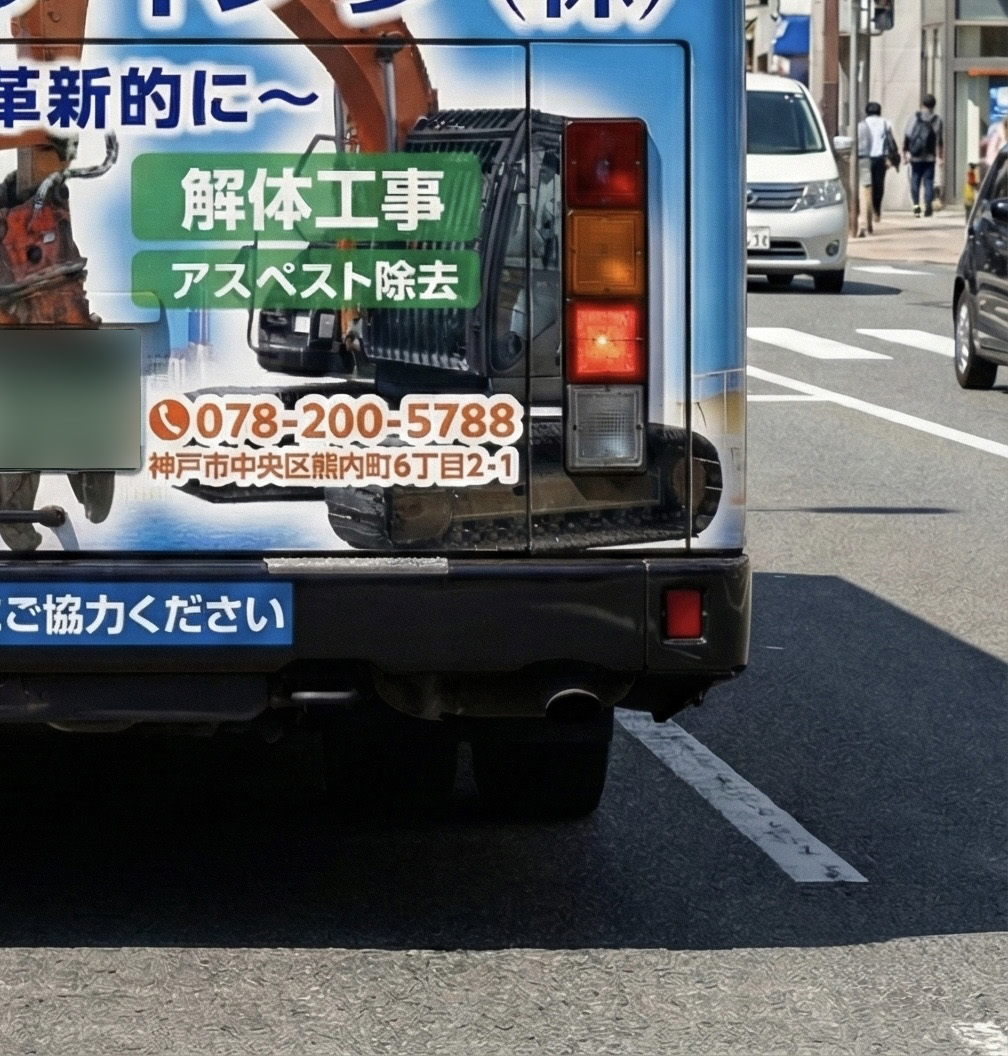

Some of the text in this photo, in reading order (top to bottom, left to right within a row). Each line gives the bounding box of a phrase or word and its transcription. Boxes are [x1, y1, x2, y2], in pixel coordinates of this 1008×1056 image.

[180, 167, 445, 231] 解体工事
[196, 402, 515, 439] 078-200-5788
[148, 452, 512, 480] 神戸市中央区熊内町6丁目2-1
